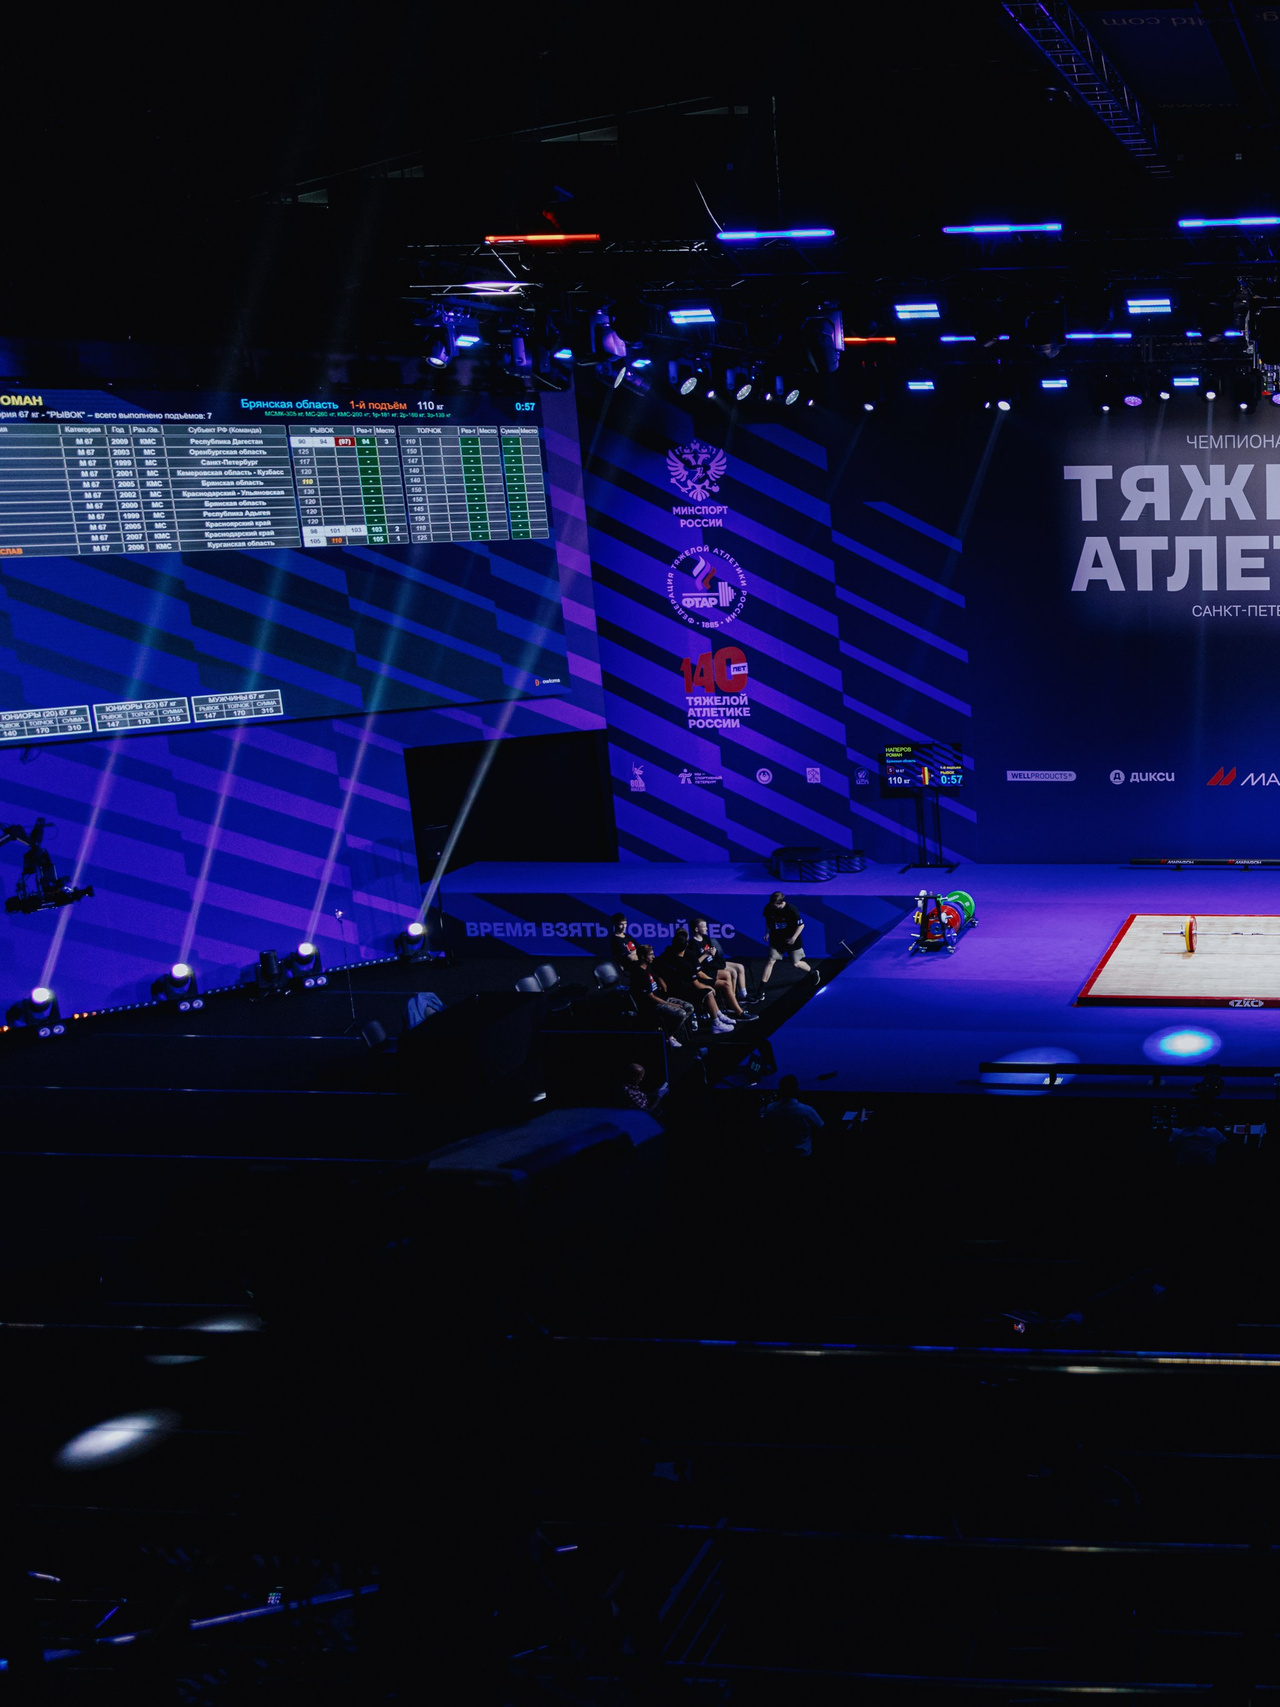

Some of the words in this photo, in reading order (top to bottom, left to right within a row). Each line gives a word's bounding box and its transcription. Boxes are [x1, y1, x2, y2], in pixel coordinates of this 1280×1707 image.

[241, 398, 293, 409] Брянская
[295, 400, 339, 409] область
[350, 400, 366, 409] 1-й
[369, 401, 407, 410] подъём
[417, 401, 435, 410] 110
[515, 402, 536, 411] 0:57
[164, 412, 206, 420] подъёмов:
[64, 426, 101, 434] Категория
[182, 490, 236, 498] Краснодарский
[673, 506, 728, 515] МИНСПОРТ
[205, 520, 254, 528] Красноярский
[680, 519, 723, 528] РОССИИ
[671, 545, 709, 569] ТЯЖЕЛОЙ
[713, 548, 747, 587] АТЛЕТИКИ
[667, 573, 694, 624] ФЕДЕРАЦИЯ
[682, 597, 718, 608] ФТАР
[725, 590, 747, 623] РОССИИ
[208, 695, 248, 703] МУЖЧИНЫ
[686, 694, 748, 706] ТЯЖЕЛОЙ
[106, 703, 142, 712] ЮНИОРЫ
[688, 707, 751, 717] АТЛЕТИКЕ
[2, 712, 41, 721] ЮНИОРЫ
[43, 710, 57, 718] (20)
[689, 719, 740, 729] РОССИИ
[941, 775, 963, 784] 0:57
[466, 921, 536, 937] ВРЕМЯ
[542, 922, 608, 938] ВЗЯТЬ
[613, 919, 688, 938] ОВЫЙ
[707, 923, 736, 939] ЕС
